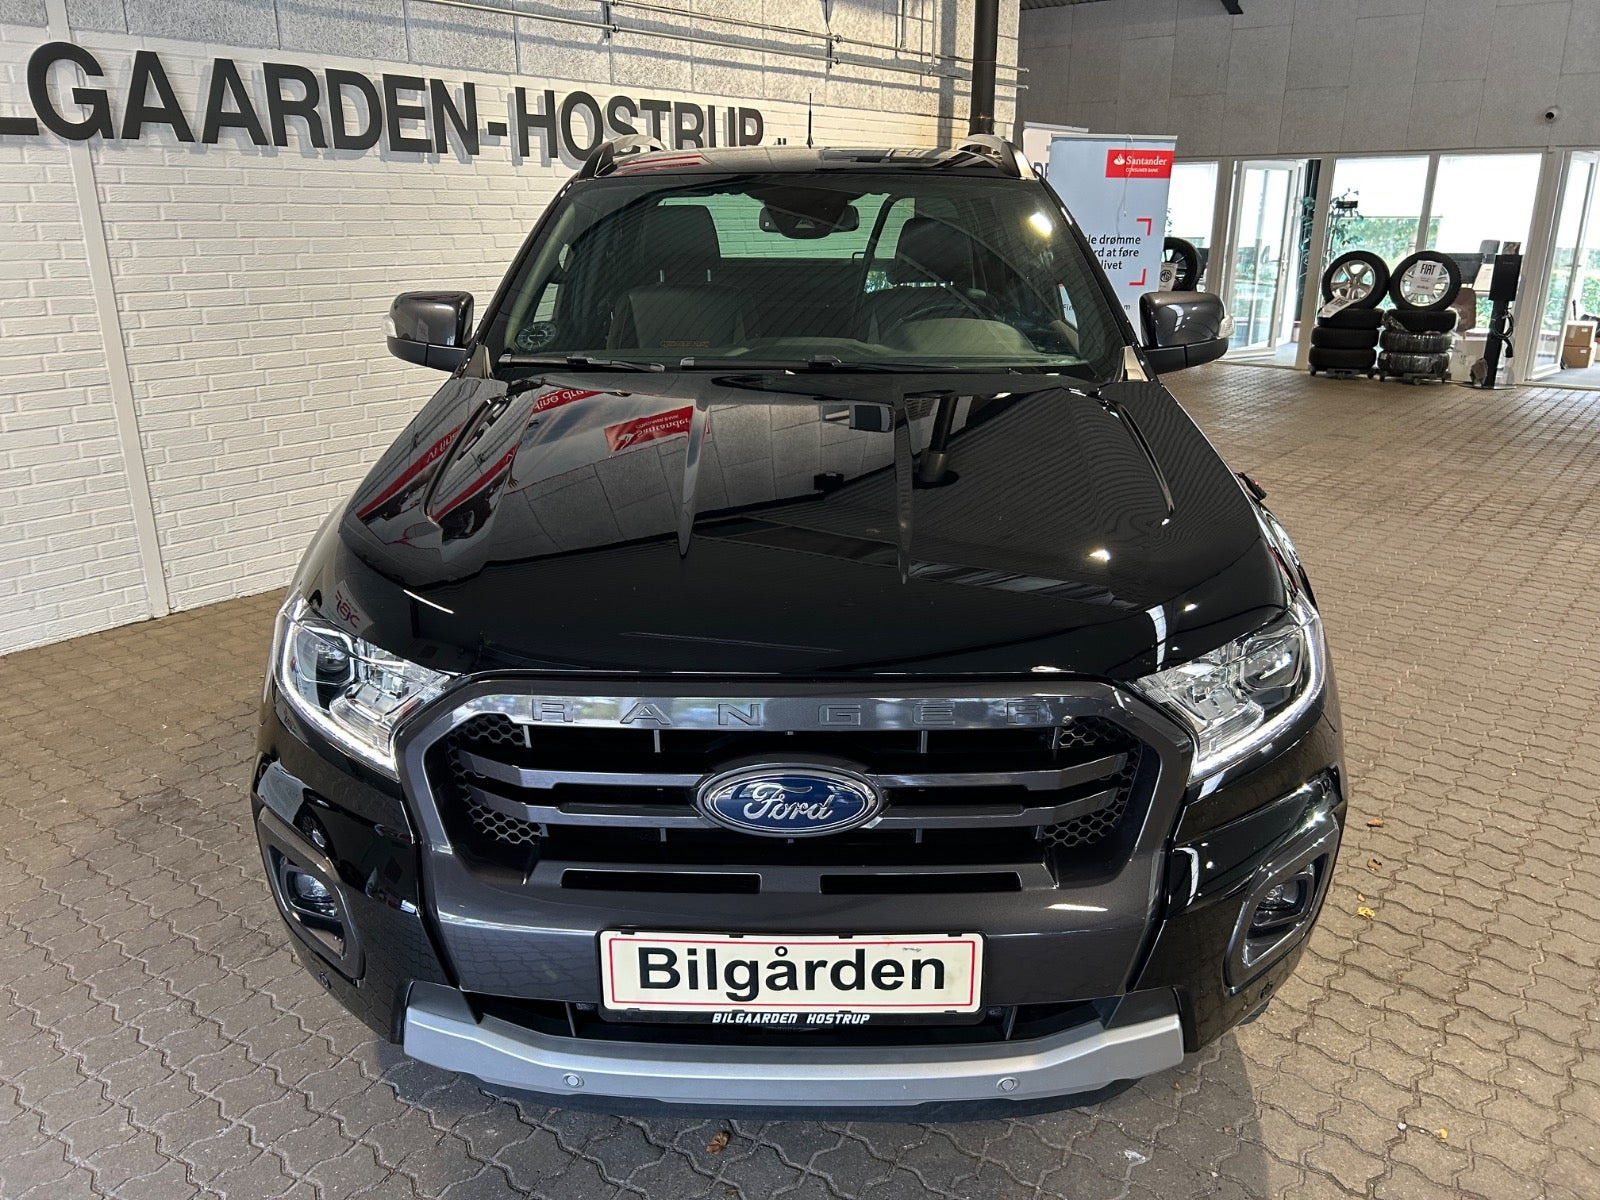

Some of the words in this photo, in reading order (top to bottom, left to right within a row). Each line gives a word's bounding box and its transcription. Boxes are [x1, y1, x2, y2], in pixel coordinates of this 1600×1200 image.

[1126, 155, 1168, 166] Santander
[1086, 234, 1097, 245] le
[1099, 234, 1141, 245] drømme
[1106, 248, 1117, 257] at
[1118, 247, 1139, 257] føre
[1101, 260, 1122, 270] livet
[1420, 263, 1437, 275] FIAT
[532, 699, 1051, 727] RANGER
[743, 782, 835, 820] Ford
[638, 946, 945, 1002] Bilgården
[712, 1013, 798, 1024] BILGAARDEN
[806, 1013, 870, 1025] HOSTRUP
